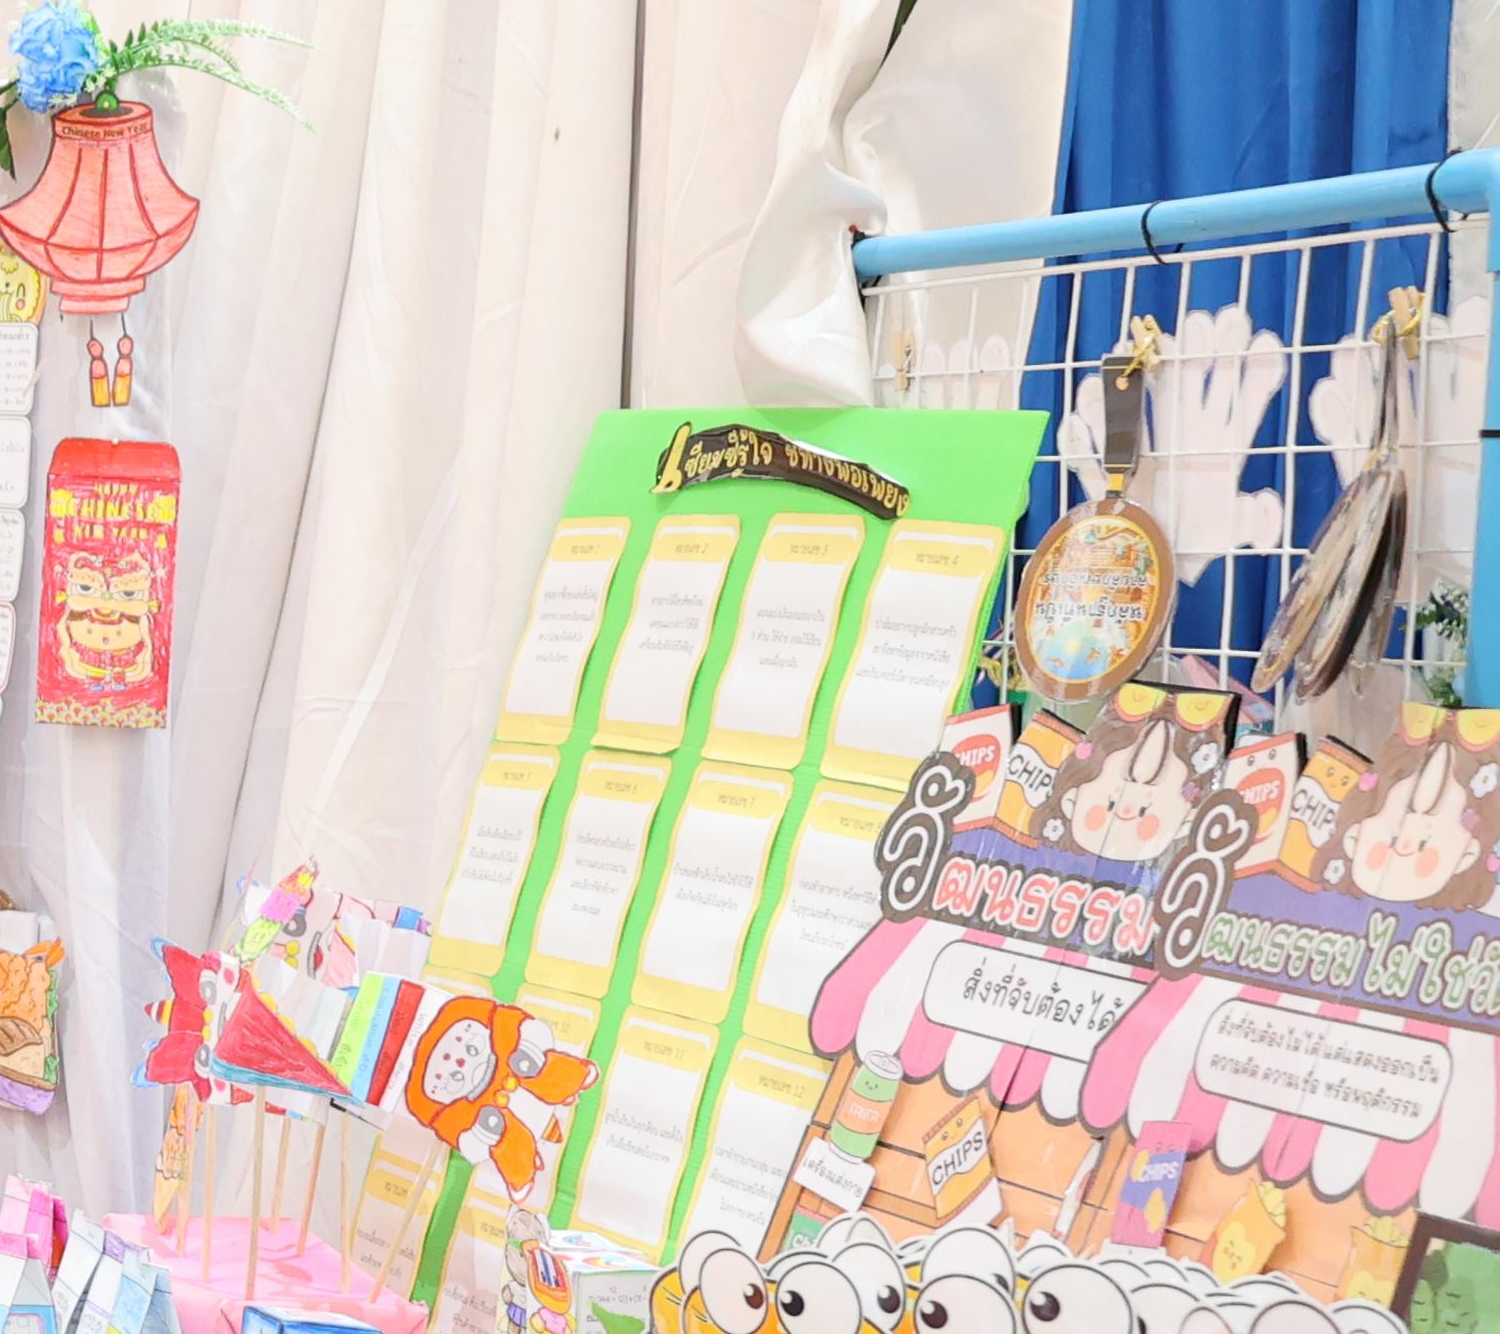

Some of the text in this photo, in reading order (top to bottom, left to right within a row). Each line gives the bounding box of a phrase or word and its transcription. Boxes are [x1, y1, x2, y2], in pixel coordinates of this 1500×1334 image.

[61, 123, 148, 140] Chinese New Year
[930, 1130, 984, 1187] CHIPS
